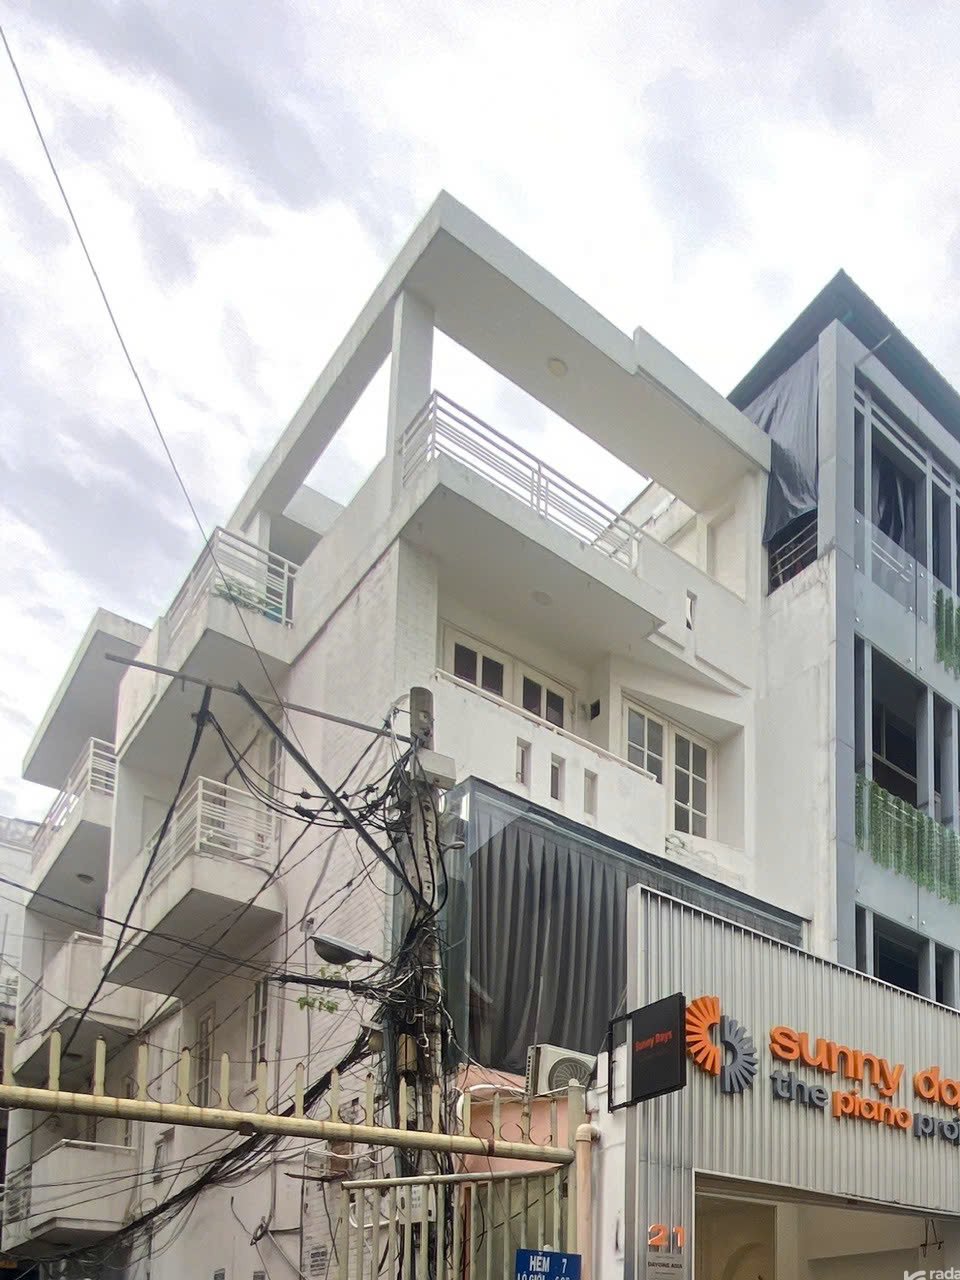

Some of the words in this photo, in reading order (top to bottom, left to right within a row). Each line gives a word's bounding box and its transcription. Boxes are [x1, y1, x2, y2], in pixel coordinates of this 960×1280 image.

[769, 1025, 904, 1097] sunny
[770, 1070, 829, 1109] the
[832, 1084, 913, 1130] piano
[648, 1223, 685, 1248] 21
[561, 1258, 568, 1273] 7
